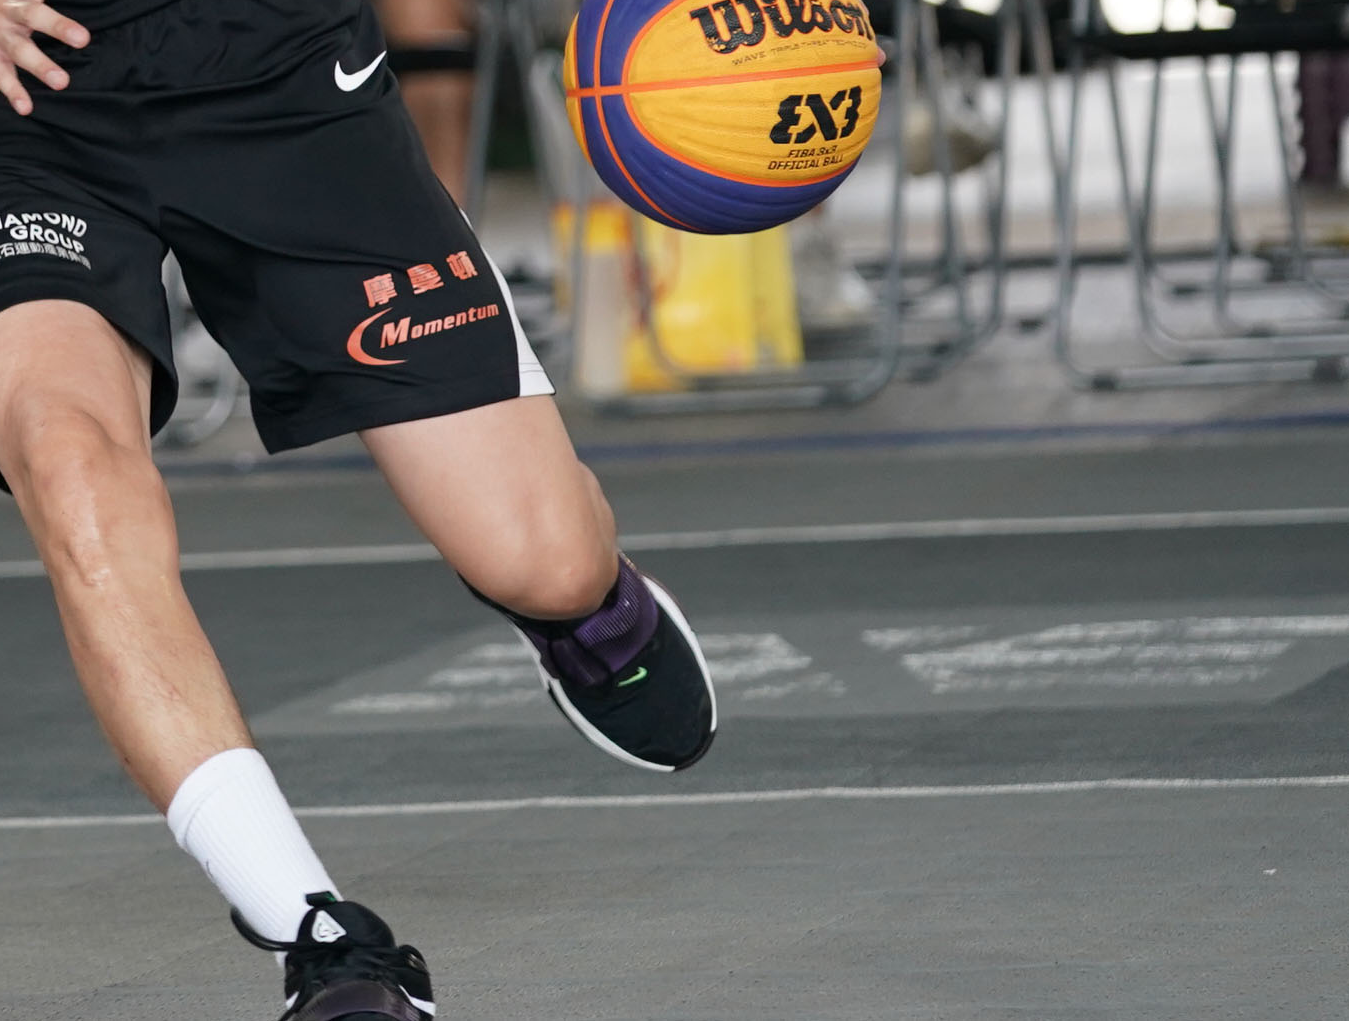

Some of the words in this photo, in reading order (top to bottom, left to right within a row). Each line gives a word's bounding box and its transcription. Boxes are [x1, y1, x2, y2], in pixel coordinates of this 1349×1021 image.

[767, 160, 820, 171] OFFICIAL
[822, 154, 844, 167] BALL
[787, 148, 816, 158] FIBA
[9, 223, 85, 254] GROUP
[379, 303, 500, 349] Momentum
